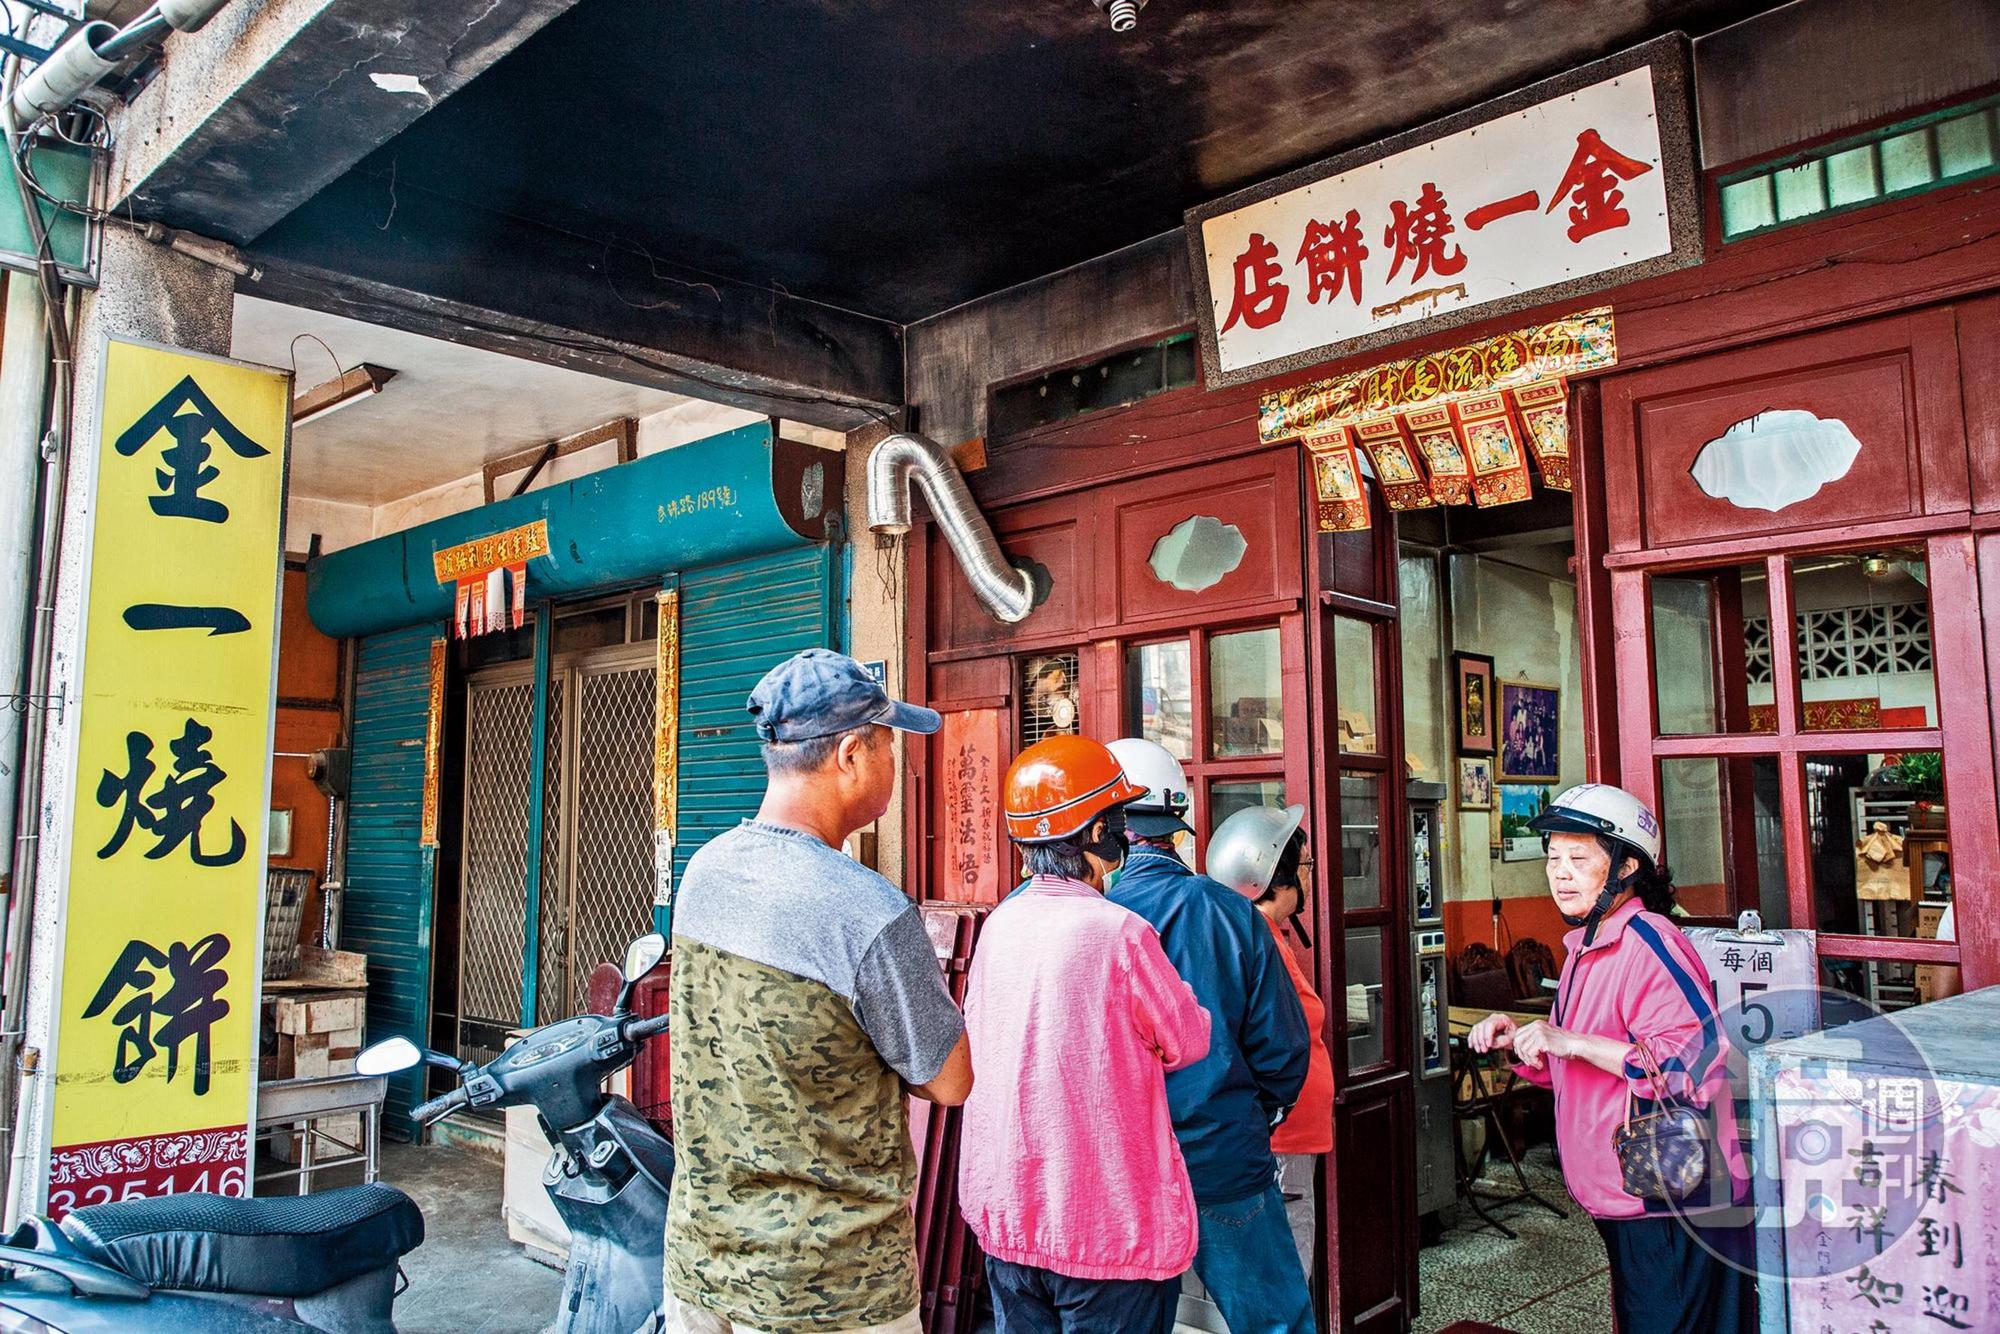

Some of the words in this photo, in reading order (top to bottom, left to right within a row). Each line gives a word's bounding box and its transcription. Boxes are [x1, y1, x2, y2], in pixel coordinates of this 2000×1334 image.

[1220, 128, 1653, 335] 金一燒餅店
[82, 375, 270, 1096] 金一燒餅
[1720, 946, 1773, 974] 每個
[1846, 1139, 1904, 1334] 吉祥如
